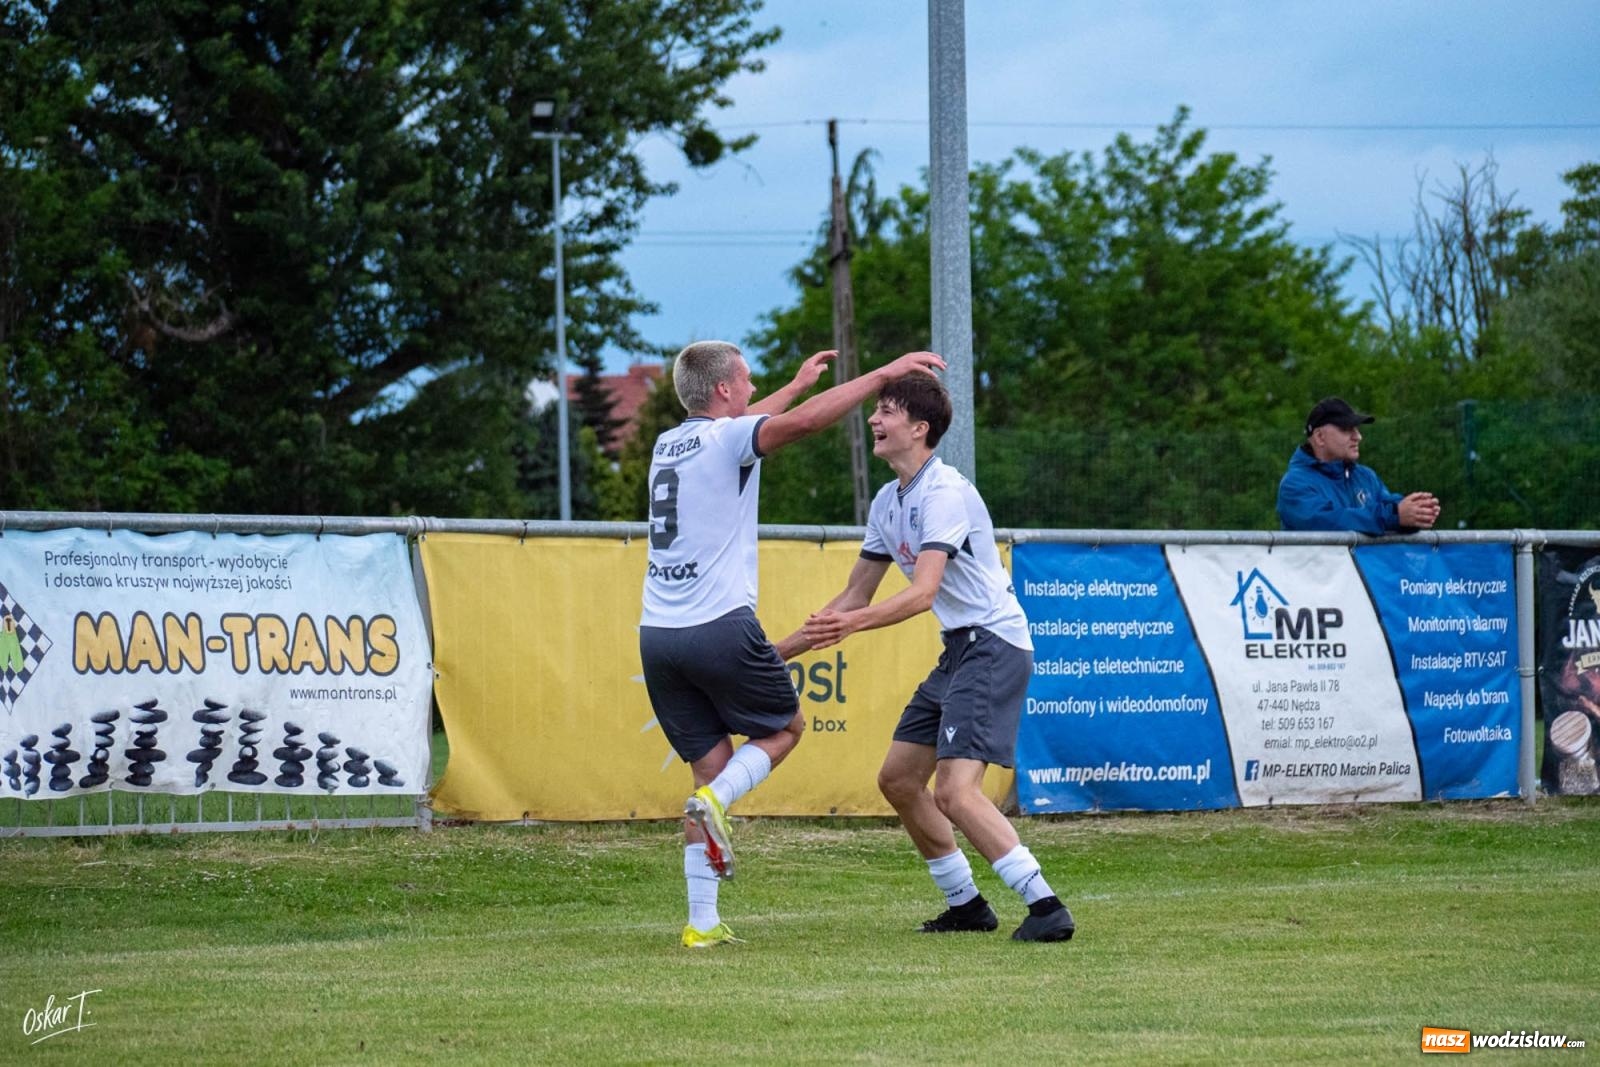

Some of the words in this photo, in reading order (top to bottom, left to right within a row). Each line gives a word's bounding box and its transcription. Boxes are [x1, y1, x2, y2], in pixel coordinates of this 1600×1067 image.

[650, 468, 680, 550] 9
[45, 551, 138, 569] Profesjonalny
[142, 553, 206, 569] transport
[218, 556, 288, 571] wydobycie
[45, 574, 49, 588] i
[54, 573, 113, 588] dostawa
[117, 575, 169, 592] kruszyw
[173, 575, 243, 593] najwyższej
[246, 575, 292, 591] jakości
[1024, 579, 1085, 600] Instalacje
[1088, 579, 1158, 600] elektryczne
[1400, 579, 1443, 598] Pomiary
[1445, 578, 1507, 598] elektryczne
[1029, 618, 1088, 640] nstalacje
[1092, 619, 1174, 639] energetyczne
[1275, 608, 1343, 640] MP
[1408, 616, 1466, 635] Monitoring
[1467, 617, 1472, 631] i
[1473, 616, 1508, 634] alarmy
[74, 611, 400, 676] MAN-TRANS
[1245, 643, 1346, 659] ELEKTRO
[1094, 658, 1184, 674] teletechniczne
[1411, 654, 1462, 672] Instalacje
[1464, 651, 1507, 669] RTV-SAT
[290, 686, 397, 701] www.mantrans.pl
[1265, 680, 1288, 693] Jana
[1290, 680, 1318, 692] Pawła
[1328, 680, 1340, 692] 78
[1027, 697, 1096, 717] Domofony
[1100, 697, 1103, 713] i
[1106, 695, 1208, 715] wideodomofony
[1257, 699, 1289, 711] 47-440
[1291, 699, 1321, 714] Nędza
[1424, 691, 1464, 710] Napędy
[1466, 690, 1480, 704] do
[1481, 689, 1509, 704] bram
[813, 716, 847, 732] box
[1278, 717, 1295, 730] 509
[1298, 717, 1315, 730] 653
[1318, 716, 1335, 729] 167
[1295, 734, 1378, 751] mp_elektro@o2.pl
[1444, 726, 1512, 744] Fotowoltaika
[1029, 759, 1211, 785] www.mpelektro.com.pl
[1262, 763, 1337, 778] MP-ELEKTRO
[1340, 762, 1376, 776] Marcin
[1379, 762, 1411, 776] Palica
